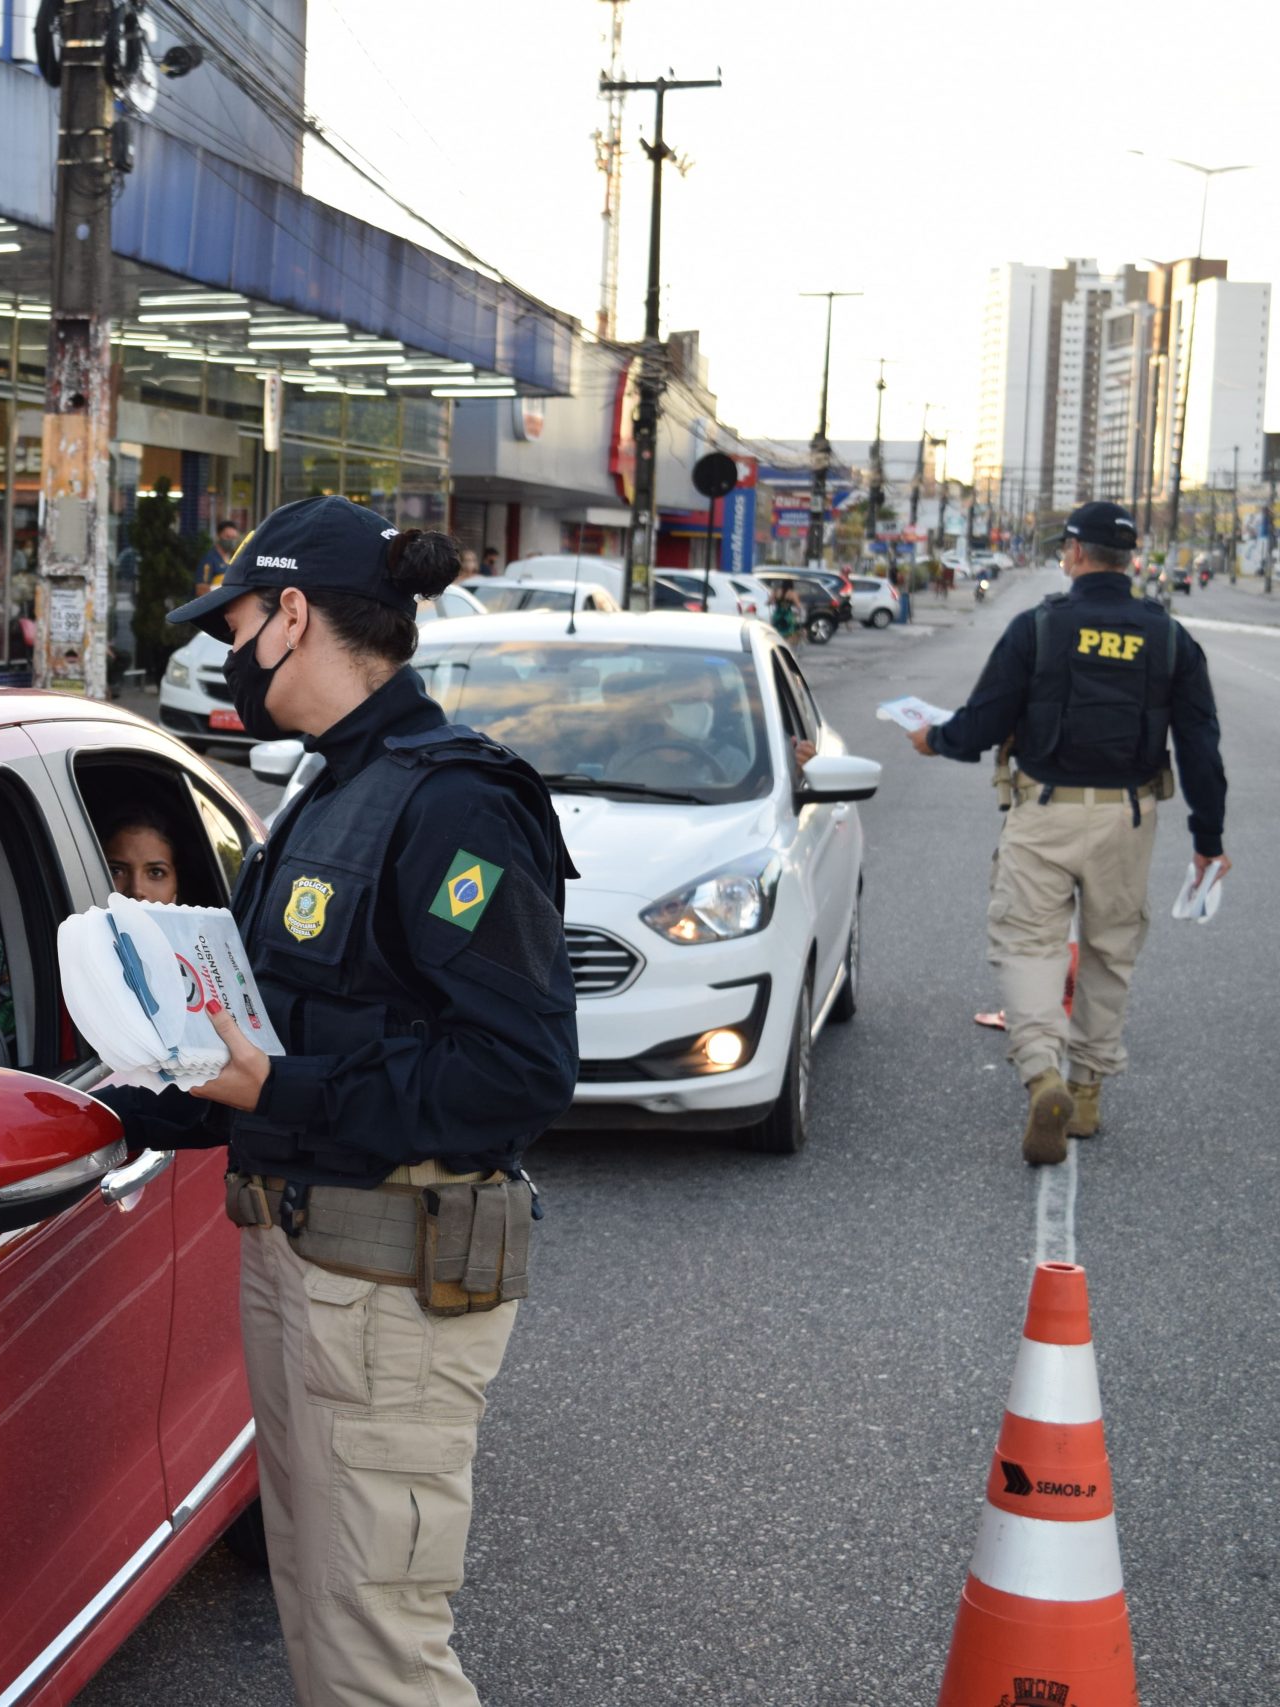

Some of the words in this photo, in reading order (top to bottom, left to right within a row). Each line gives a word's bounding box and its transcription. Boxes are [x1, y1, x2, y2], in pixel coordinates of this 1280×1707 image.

[256, 555, 299, 570] BRASIL
[1078, 628, 1145, 661] PRF
[194, 944, 204, 960] DA
[221, 993, 232, 1010] NO
[1036, 1480, 1097, 1498] SEMOB-JP
